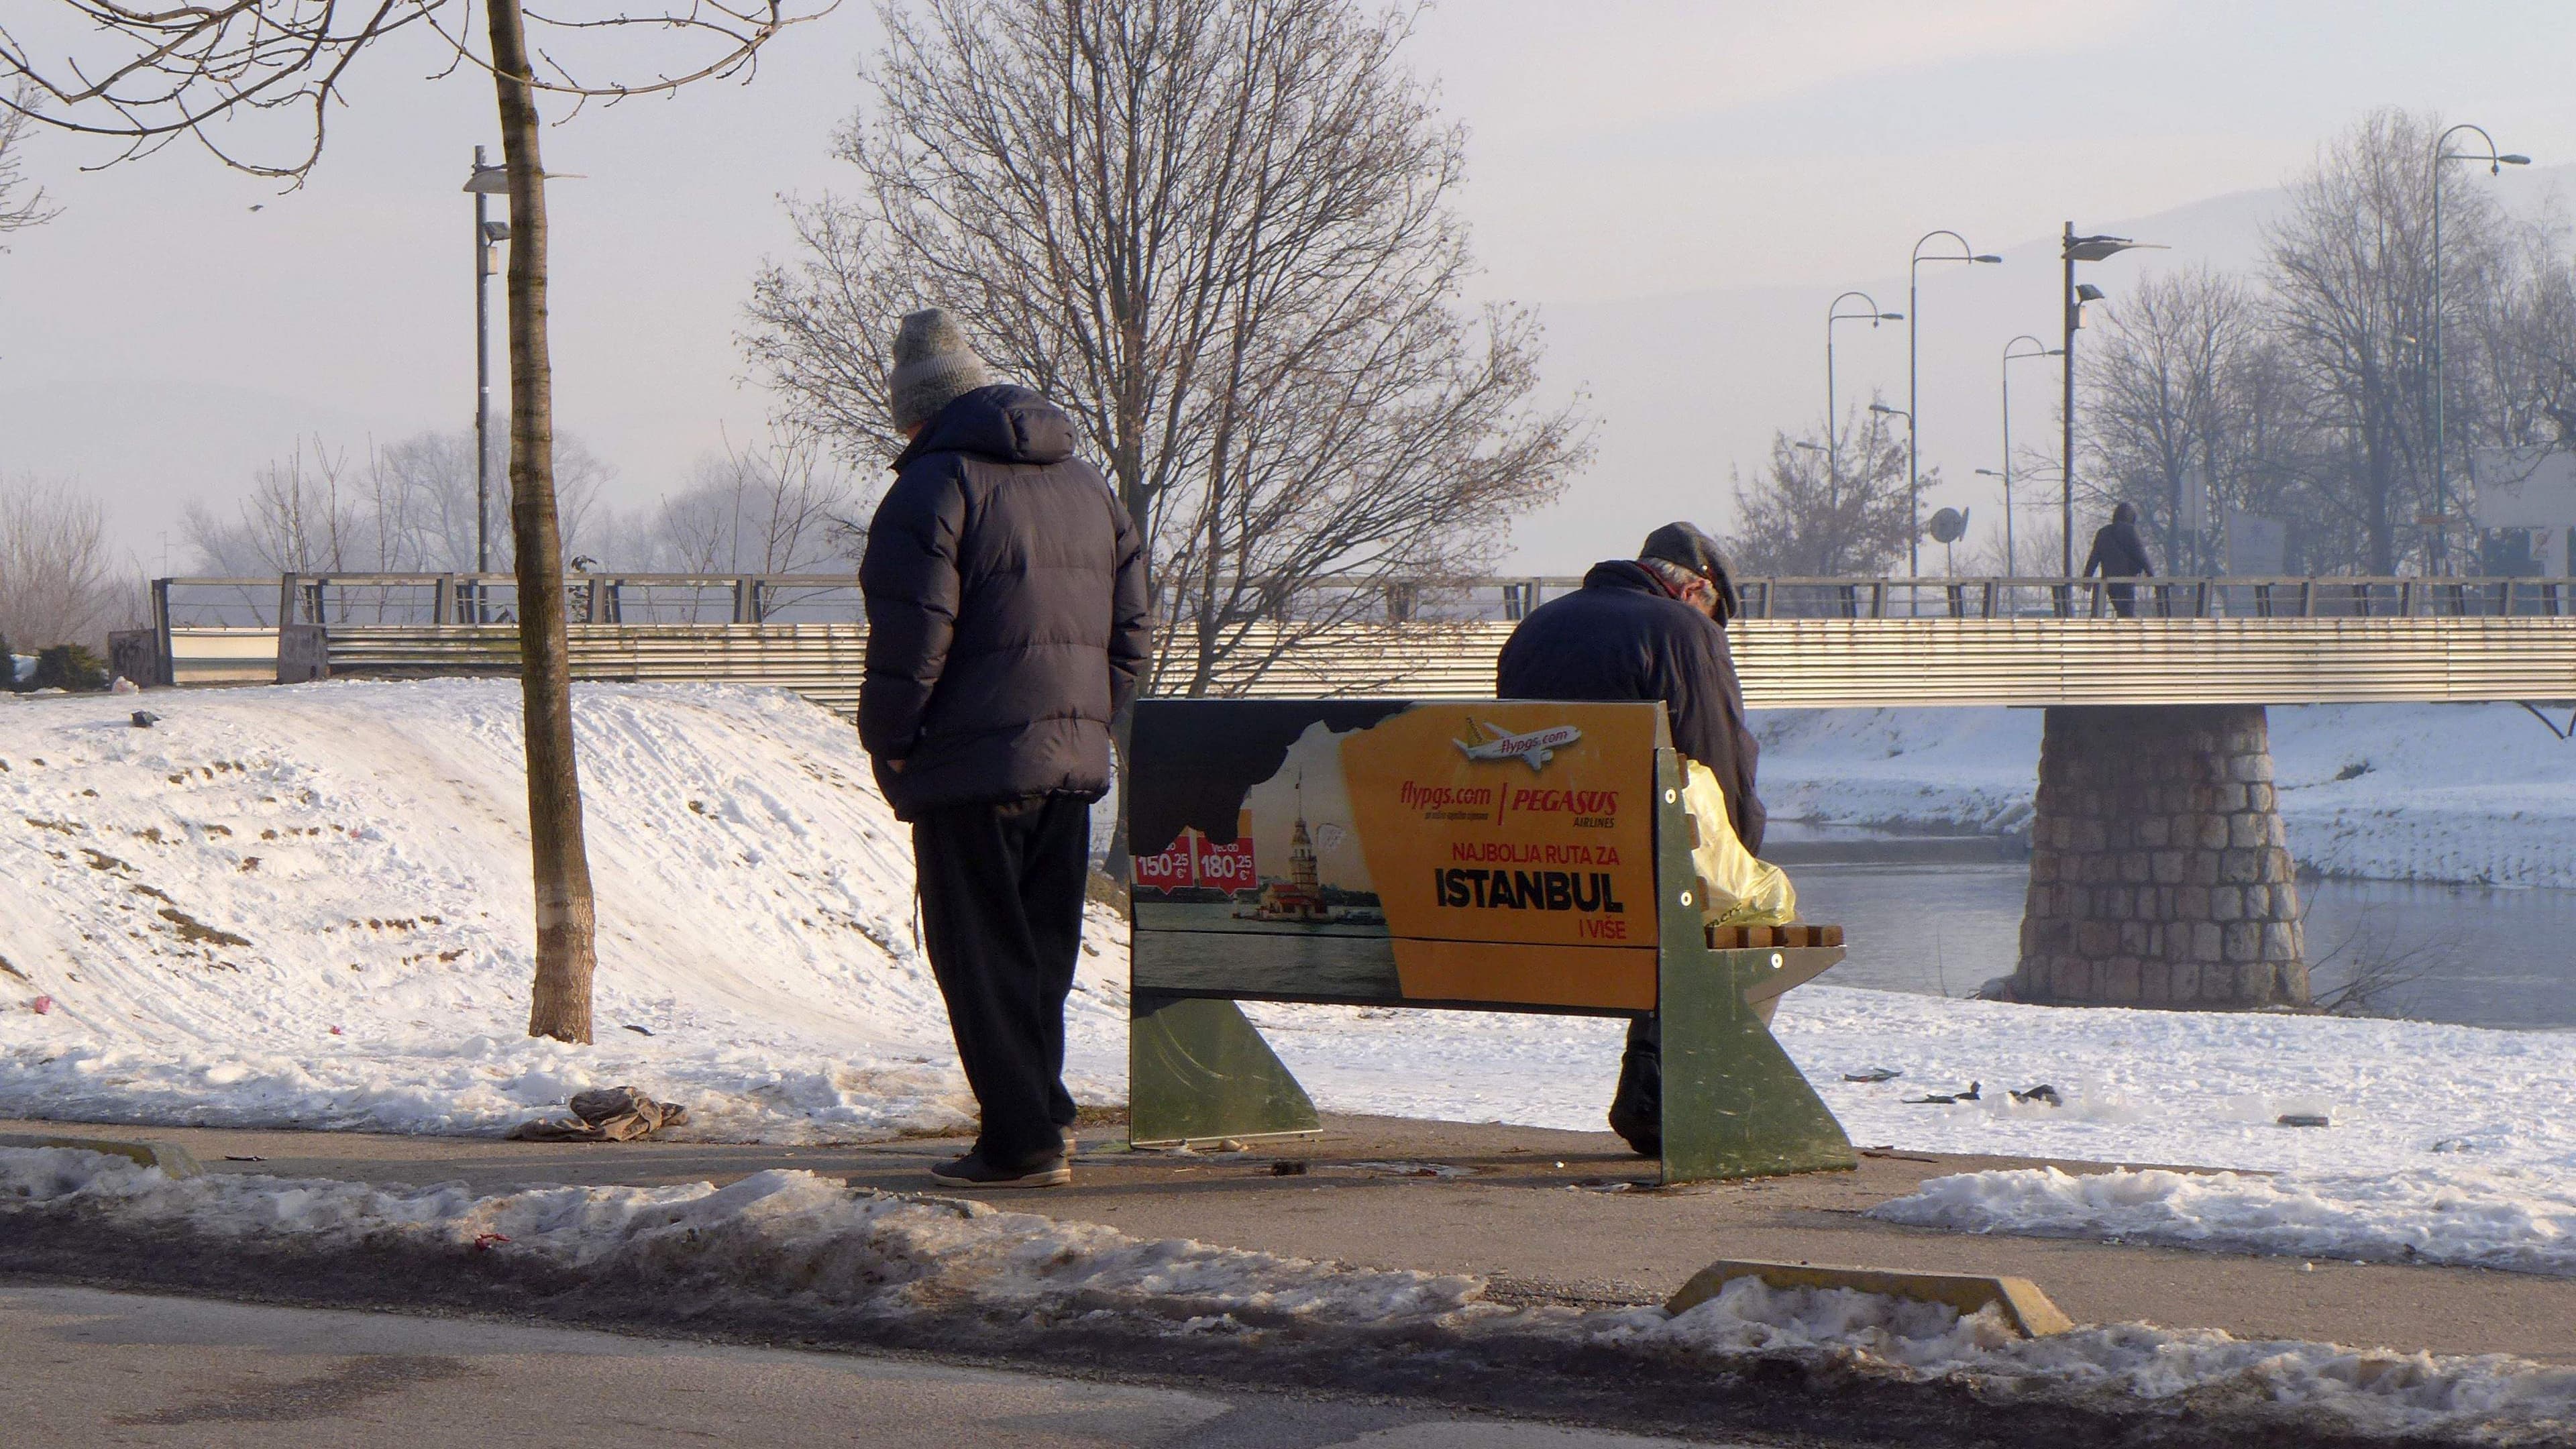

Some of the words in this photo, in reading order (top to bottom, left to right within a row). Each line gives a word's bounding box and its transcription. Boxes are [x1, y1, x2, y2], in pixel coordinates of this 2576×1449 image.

[1501, 731, 1568, 753] flypgs.com
[1401, 780, 1491, 810] flypgs.com
[1511, 789, 1619, 816] PEGASUS
[1572, 816, 1615, 828] AIRLINES
[1452, 843, 1542, 863] NAJBOLJA
[1545, 845, 1593, 865] RUTA
[1595, 846, 1620, 865] ZA
[1435, 868, 1623, 913] ISTANBUL
[1579, 920, 1585, 937] I
[1587, 916, 1627, 939] VIŠE
